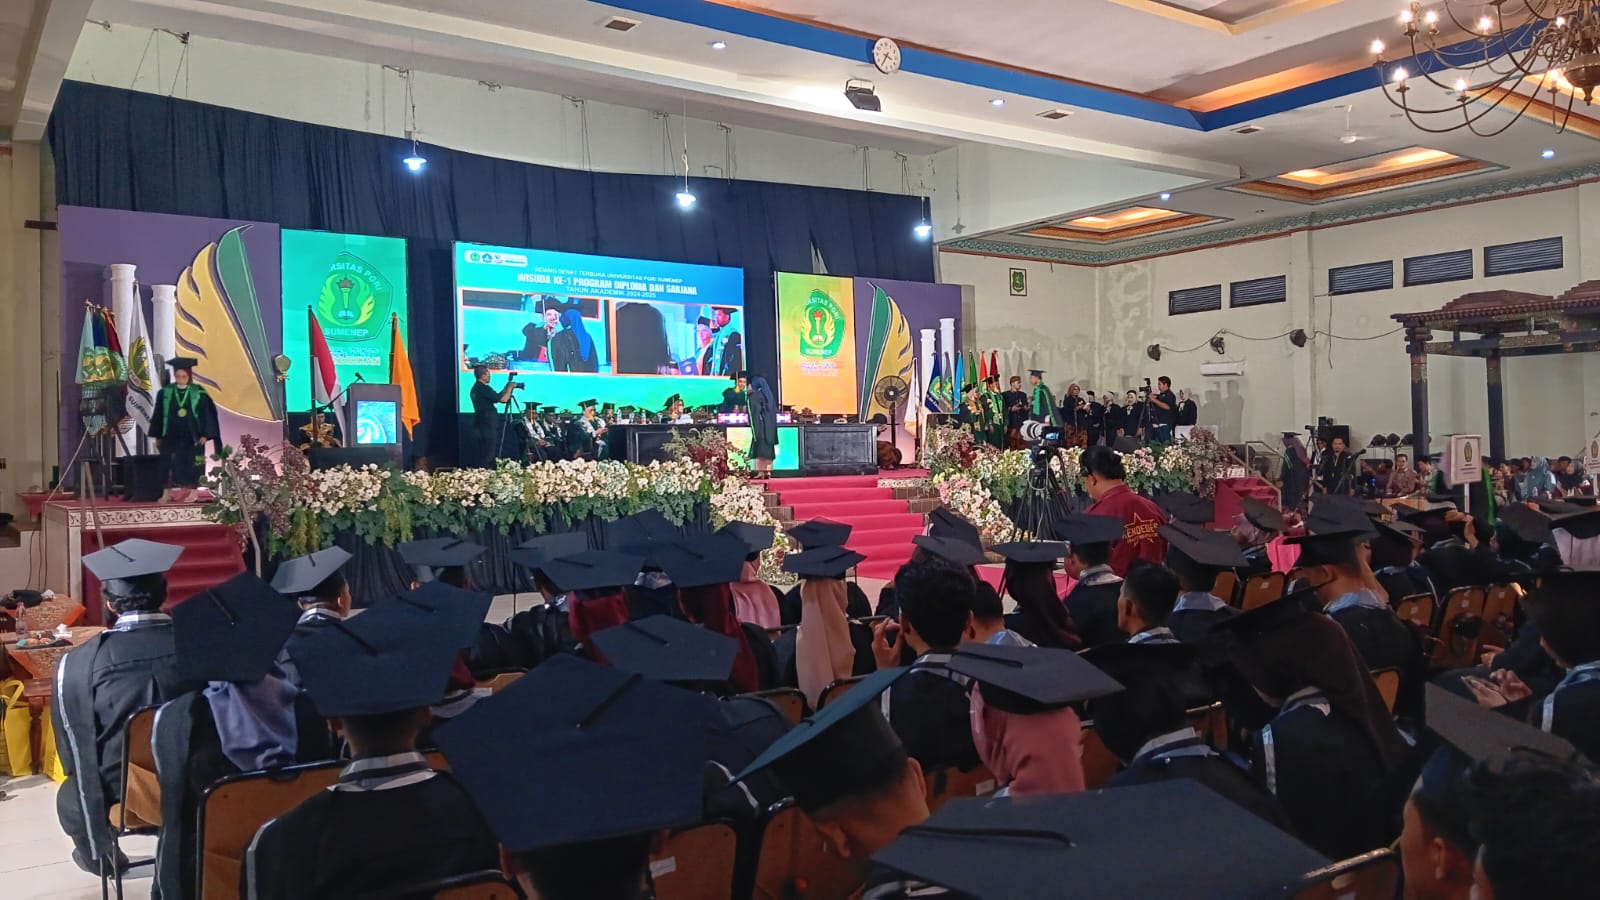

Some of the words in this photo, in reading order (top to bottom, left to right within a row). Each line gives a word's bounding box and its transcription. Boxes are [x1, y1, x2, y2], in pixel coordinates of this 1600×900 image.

[579, 269, 605, 277] TERBUKA
[607, 273, 642, 281] UNIVERSITAS
[517, 272, 550, 284] WISUDA
[553, 275, 570, 286] KE-1
[573, 276, 611, 289] PROGRAM
[614, 280, 646, 292] DIPLOMA
[649, 283, 663, 294] DAN
[666, 284, 697, 296] SARJANA
[566, 285, 588, 293] TAHUN
[590, 287, 624, 296] AKADEMIK
